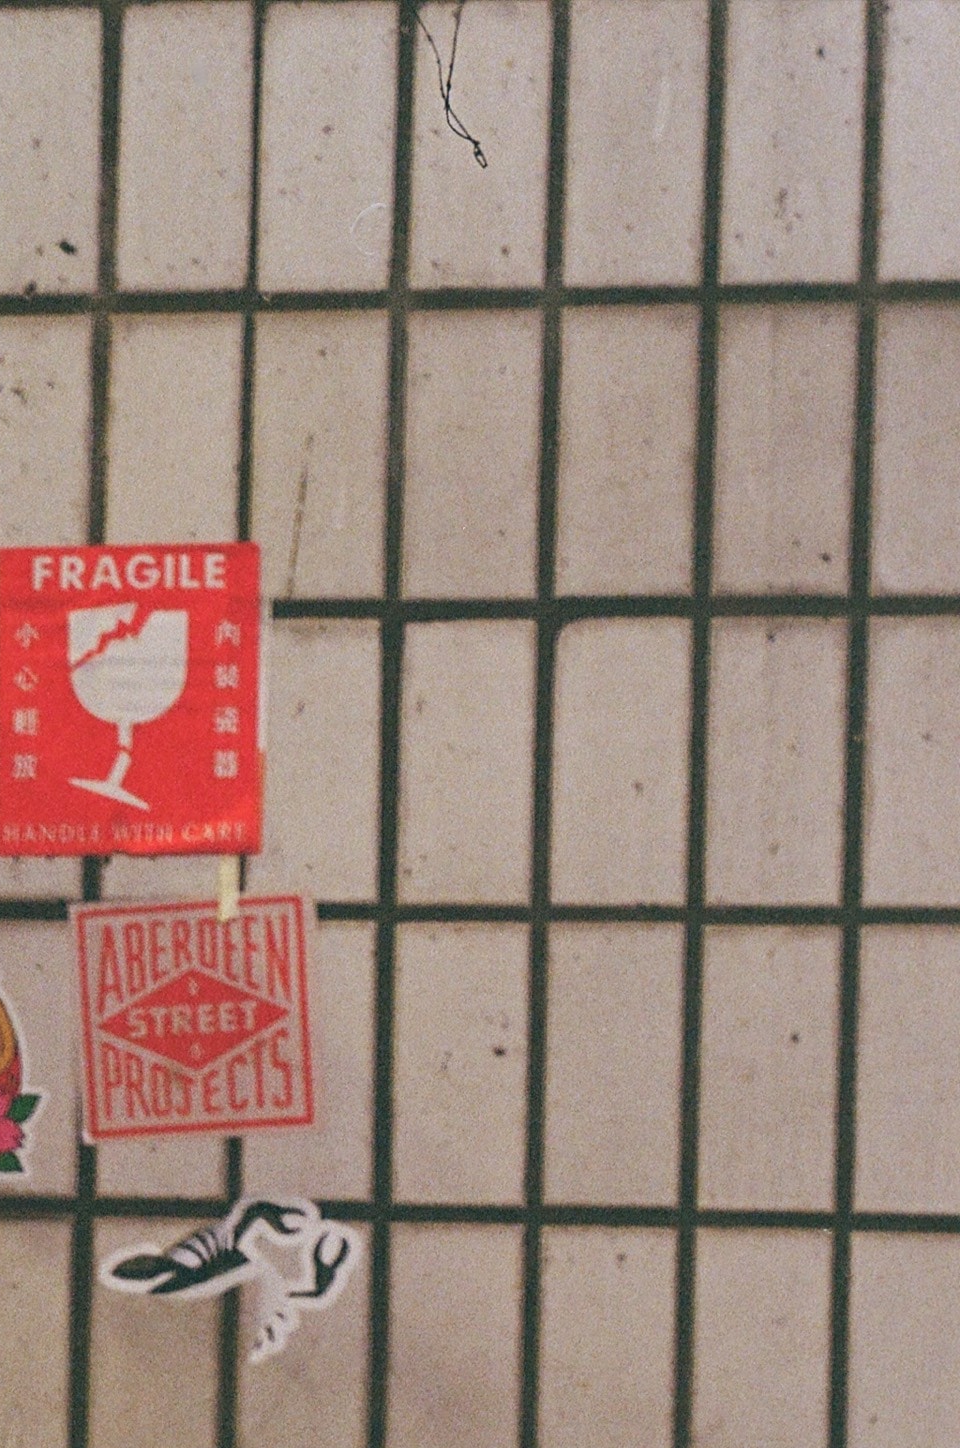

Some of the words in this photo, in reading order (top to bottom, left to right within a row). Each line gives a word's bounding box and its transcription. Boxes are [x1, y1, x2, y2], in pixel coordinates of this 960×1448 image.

[32, 554, 227, 590] FRAGILE
[112, 823, 173, 843] WITH
[181, 821, 246, 842] CARE
[97, 914, 290, 1015] ABERDEEN
[127, 1001, 258, 1038] STREET
[100, 1027, 292, 1121] PROJECTS
